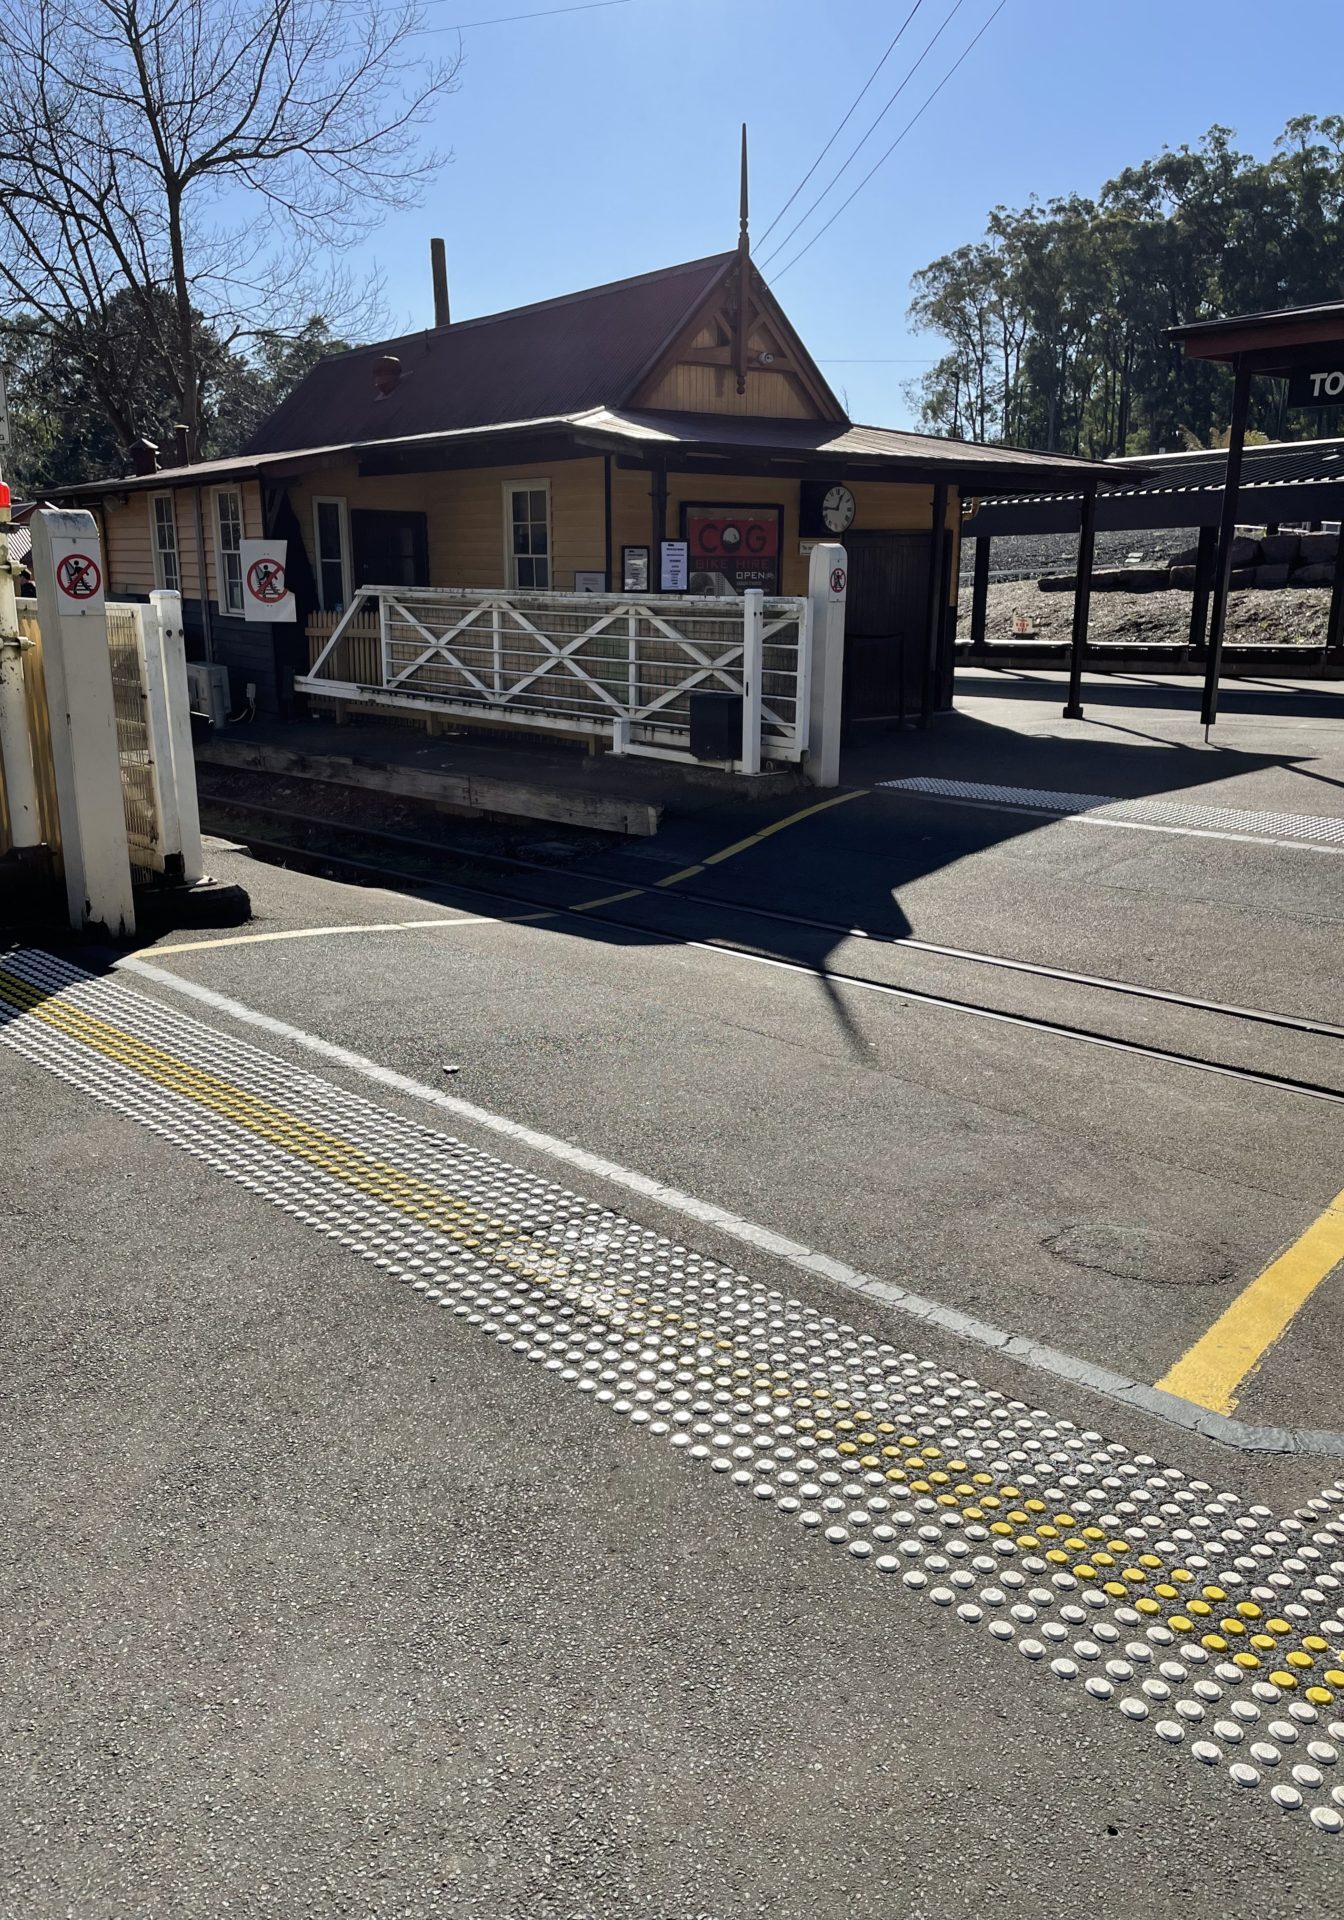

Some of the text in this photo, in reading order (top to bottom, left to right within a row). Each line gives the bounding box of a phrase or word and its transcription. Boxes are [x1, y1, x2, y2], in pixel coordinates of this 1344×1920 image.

[1310, 371, 1344, 397] TO
[698, 523, 768, 553] COG
[695, 559, 769, 569] BIKE HIRE
[736, 571, 765, 580] OPEN
